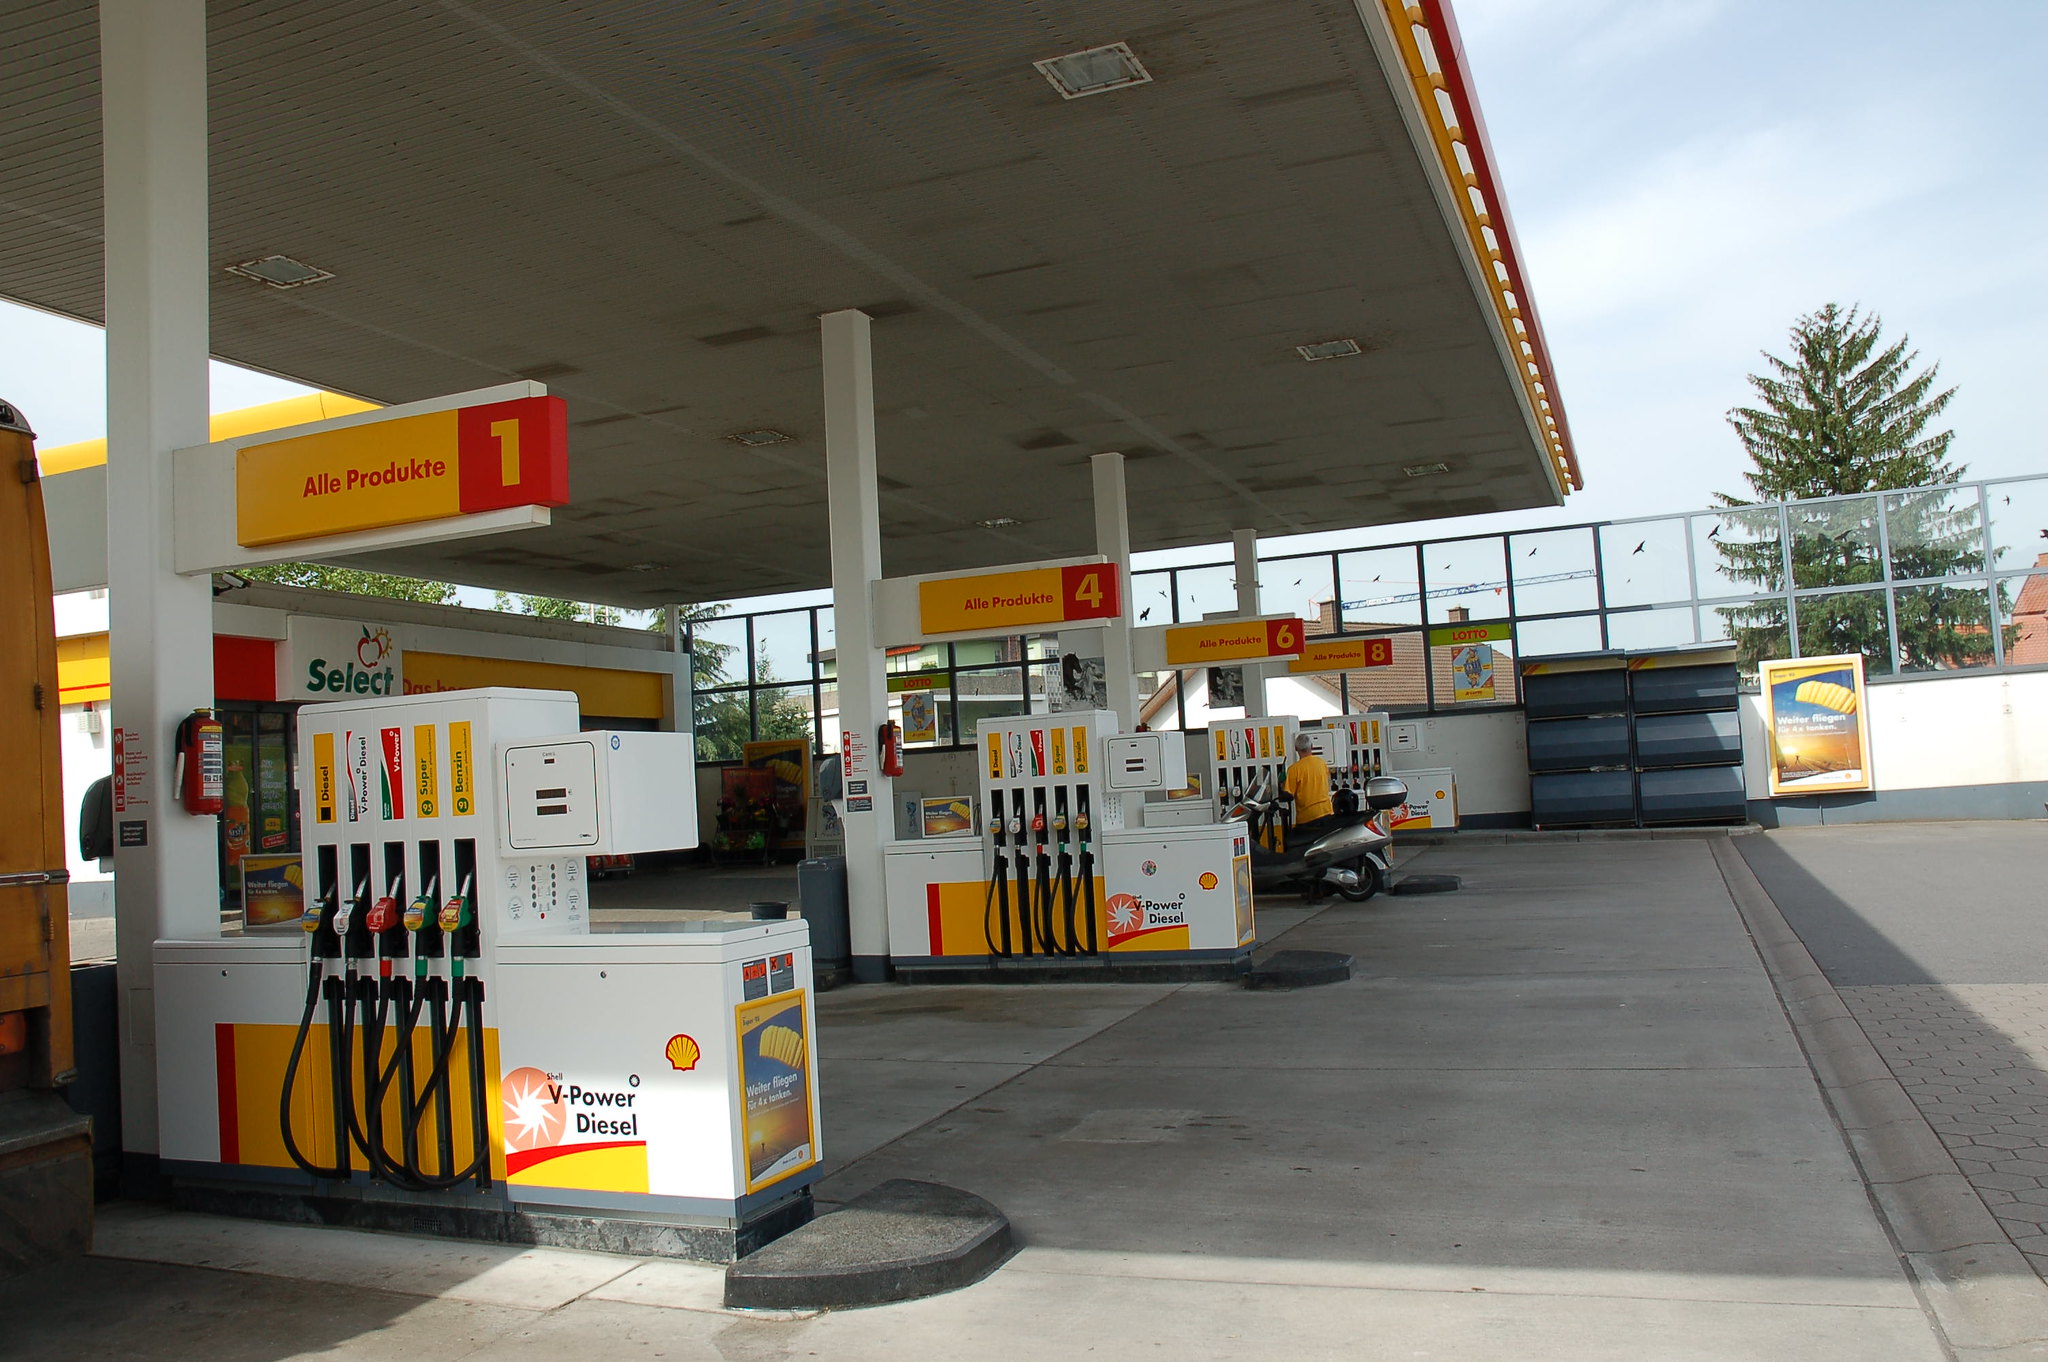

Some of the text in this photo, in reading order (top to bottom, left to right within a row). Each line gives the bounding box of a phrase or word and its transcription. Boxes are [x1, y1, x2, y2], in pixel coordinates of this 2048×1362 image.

[490, 418, 521, 488] 1
[303, 458, 446, 498] Alle Produkte
[964, 593, 1054, 611] Alle Produkte
[1075, 573, 1103, 609] 4
[1199, 636, 1262, 649] Alle Produkte
[1276, 624, 1295, 649] 6
[1452, 629, 1489, 641] LOTTO
[1313, 651, 1361, 661] Alle Produkte
[1371, 643, 1385, 662] 8
[306, 658, 394, 696] Select
[903, 678, 932, 689] LOTTO
[1777, 713, 1846, 725] Weiter fliegen
[1806, 723, 1838, 731] tanken.
[393, 732, 401, 773] V-Power
[358, 736, 369, 813] V-Power Diesel
[419, 758, 430, 796] Super
[453, 751, 463, 793] Benzin
[320, 766, 329, 801] Diesel
[422, 803, 433, 812] 95
[457, 801, 467, 810] 91
[1133, 900, 1184, 911] V-Power
[1149, 911, 1184, 923] Diesel
[546, 1072, 563, 1081] Shell
[746, 1073, 798, 1097] Weiter fliegen
[547, 1084, 636, 1108] V-Power
[747, 1100, 757, 1111] für
[769, 1089, 792, 1103] tanken.
[576, 1112, 638, 1136] Diesel
